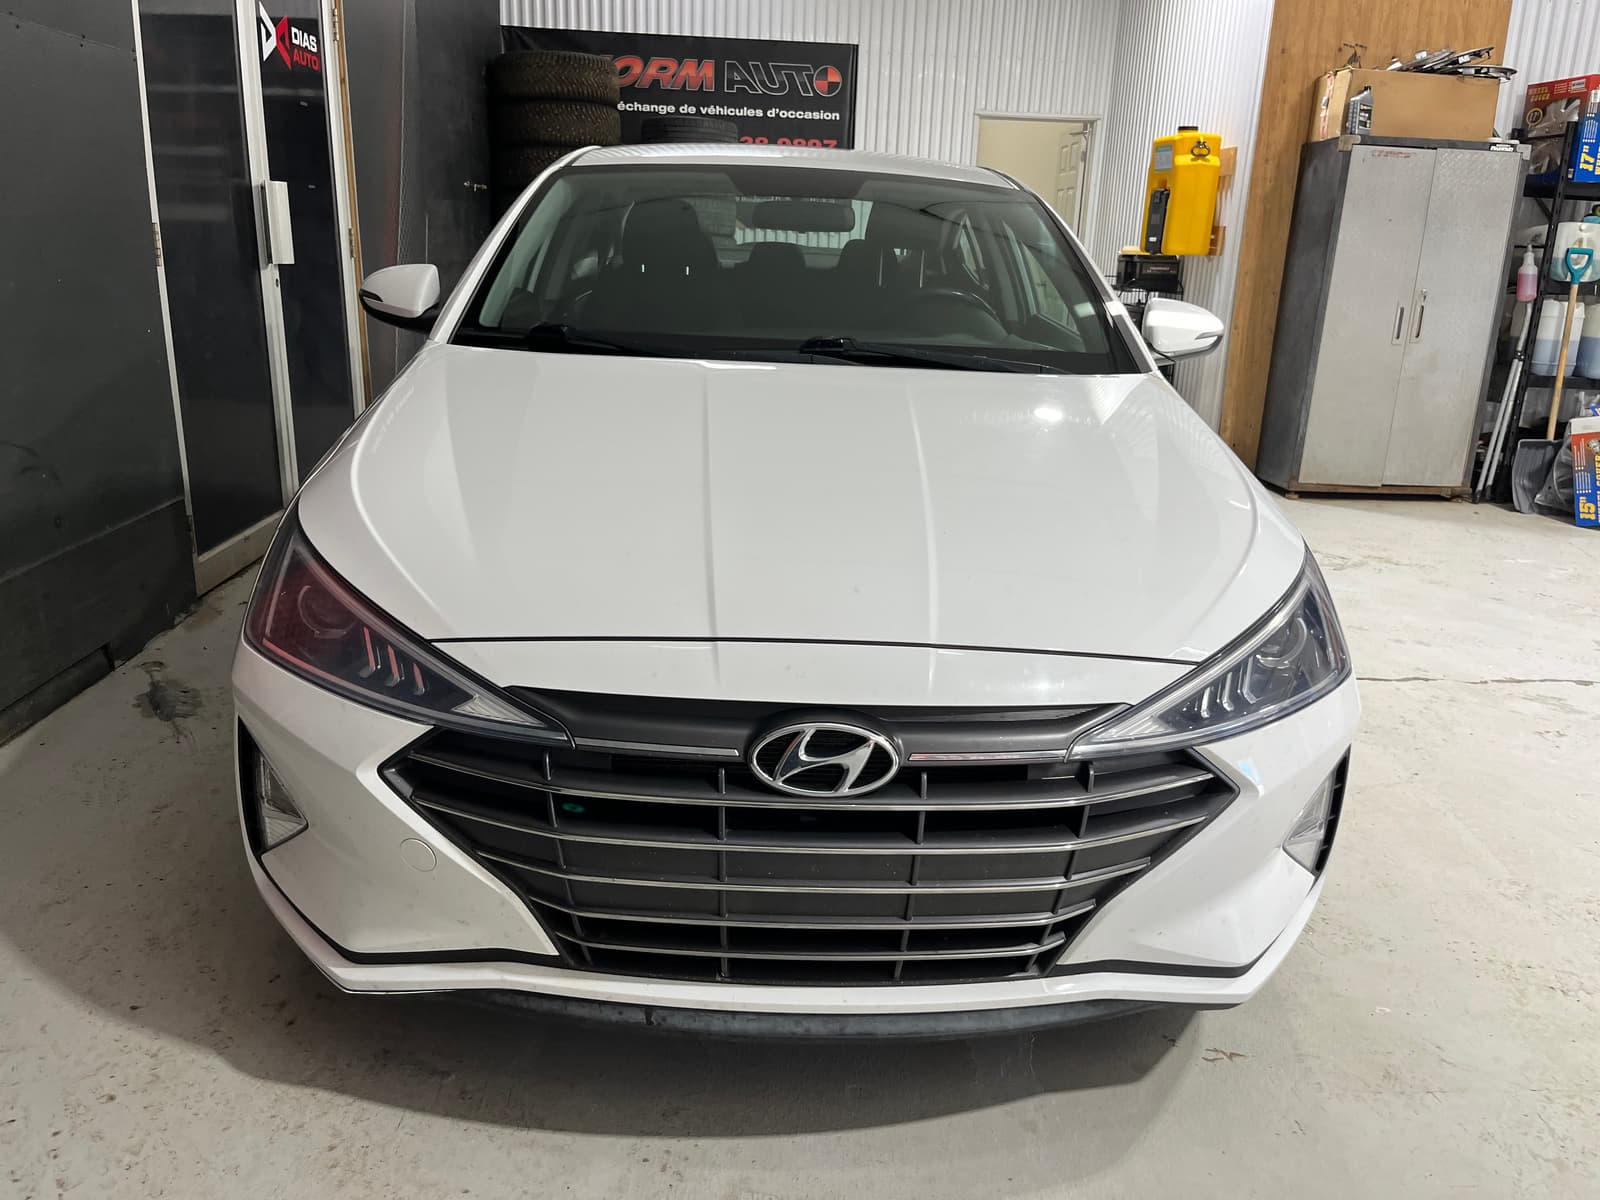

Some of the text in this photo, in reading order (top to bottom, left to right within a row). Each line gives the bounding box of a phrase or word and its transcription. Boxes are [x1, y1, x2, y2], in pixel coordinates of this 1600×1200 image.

[291, 26, 318, 52] DIAS
[293, 48, 321, 71] AUTO
[724, 60, 843, 97] AUTO
[616, 100, 840, 121] échange de véhicules d'occasion
